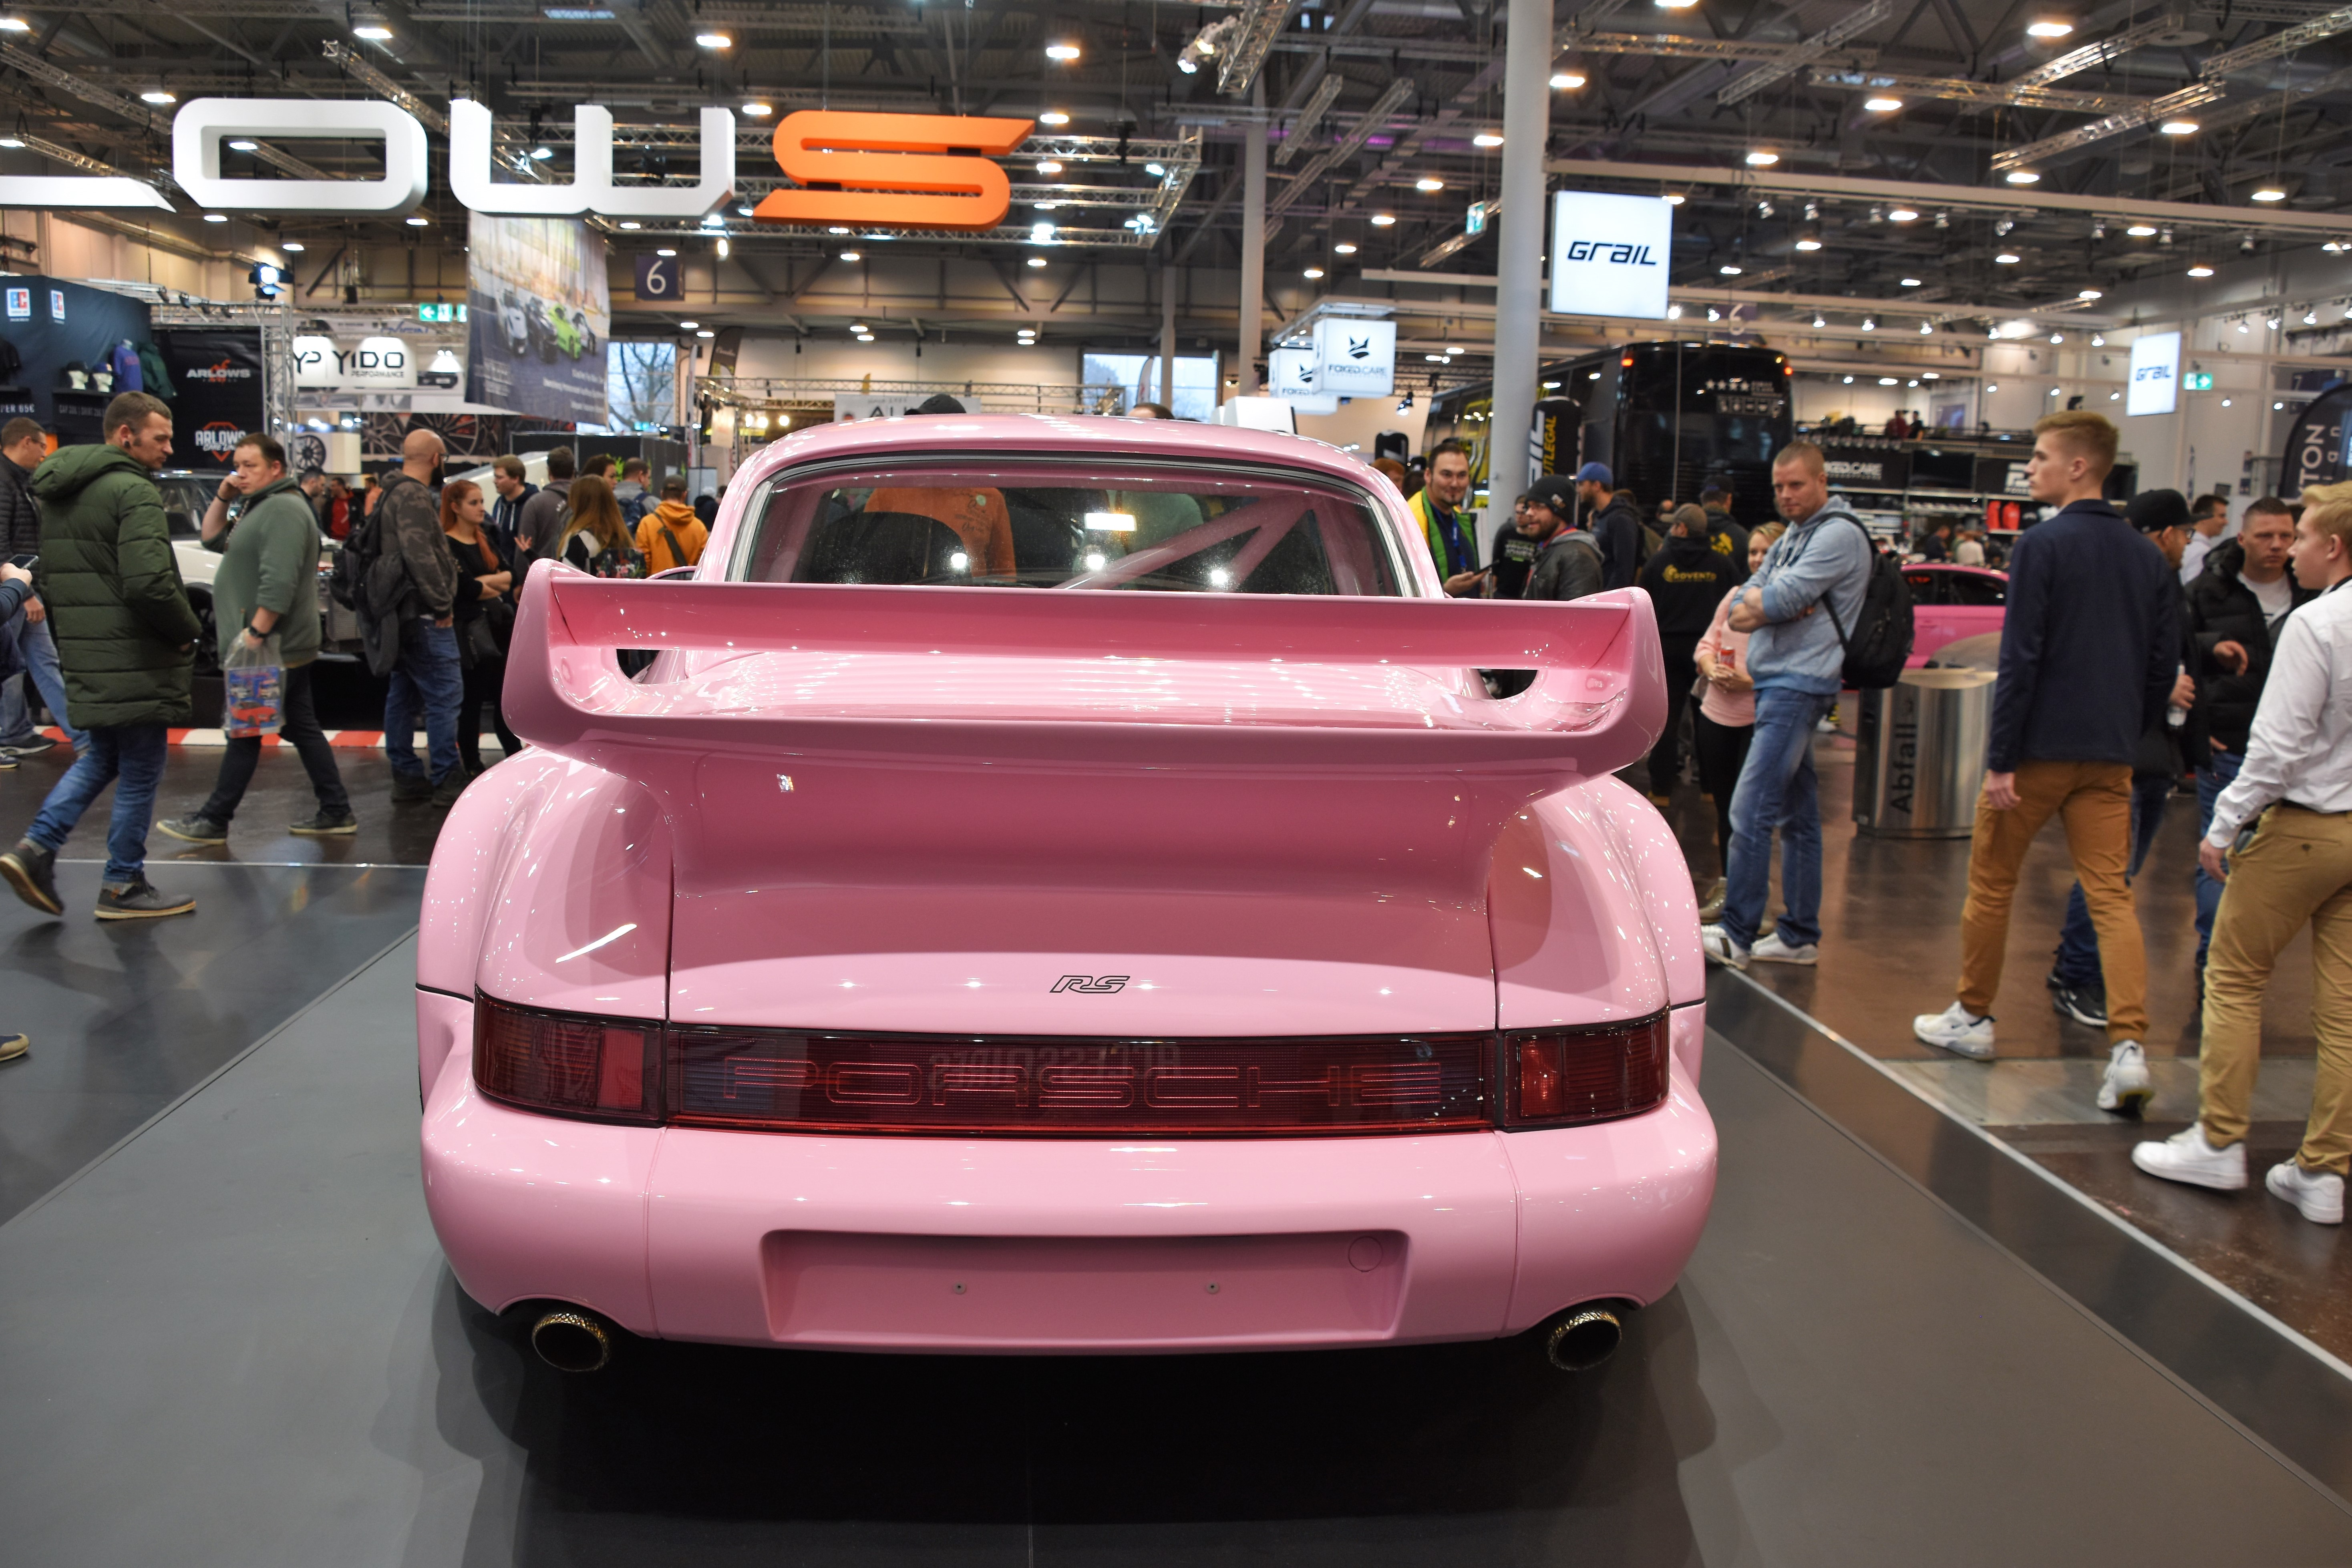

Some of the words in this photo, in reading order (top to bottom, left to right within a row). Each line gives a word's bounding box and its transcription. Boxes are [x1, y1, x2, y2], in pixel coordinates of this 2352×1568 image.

[647, 260, 666, 294] 6
[186, 368, 251, 378] ARLOWS
[332, 350, 404, 375] YIDO
[2298, 424, 2326, 493] TON
[1890, 723, 1917, 814] Abfall
[1049, 975, 1130, 993] RS
[723, 1057, 1441, 1108] PORSCHE
